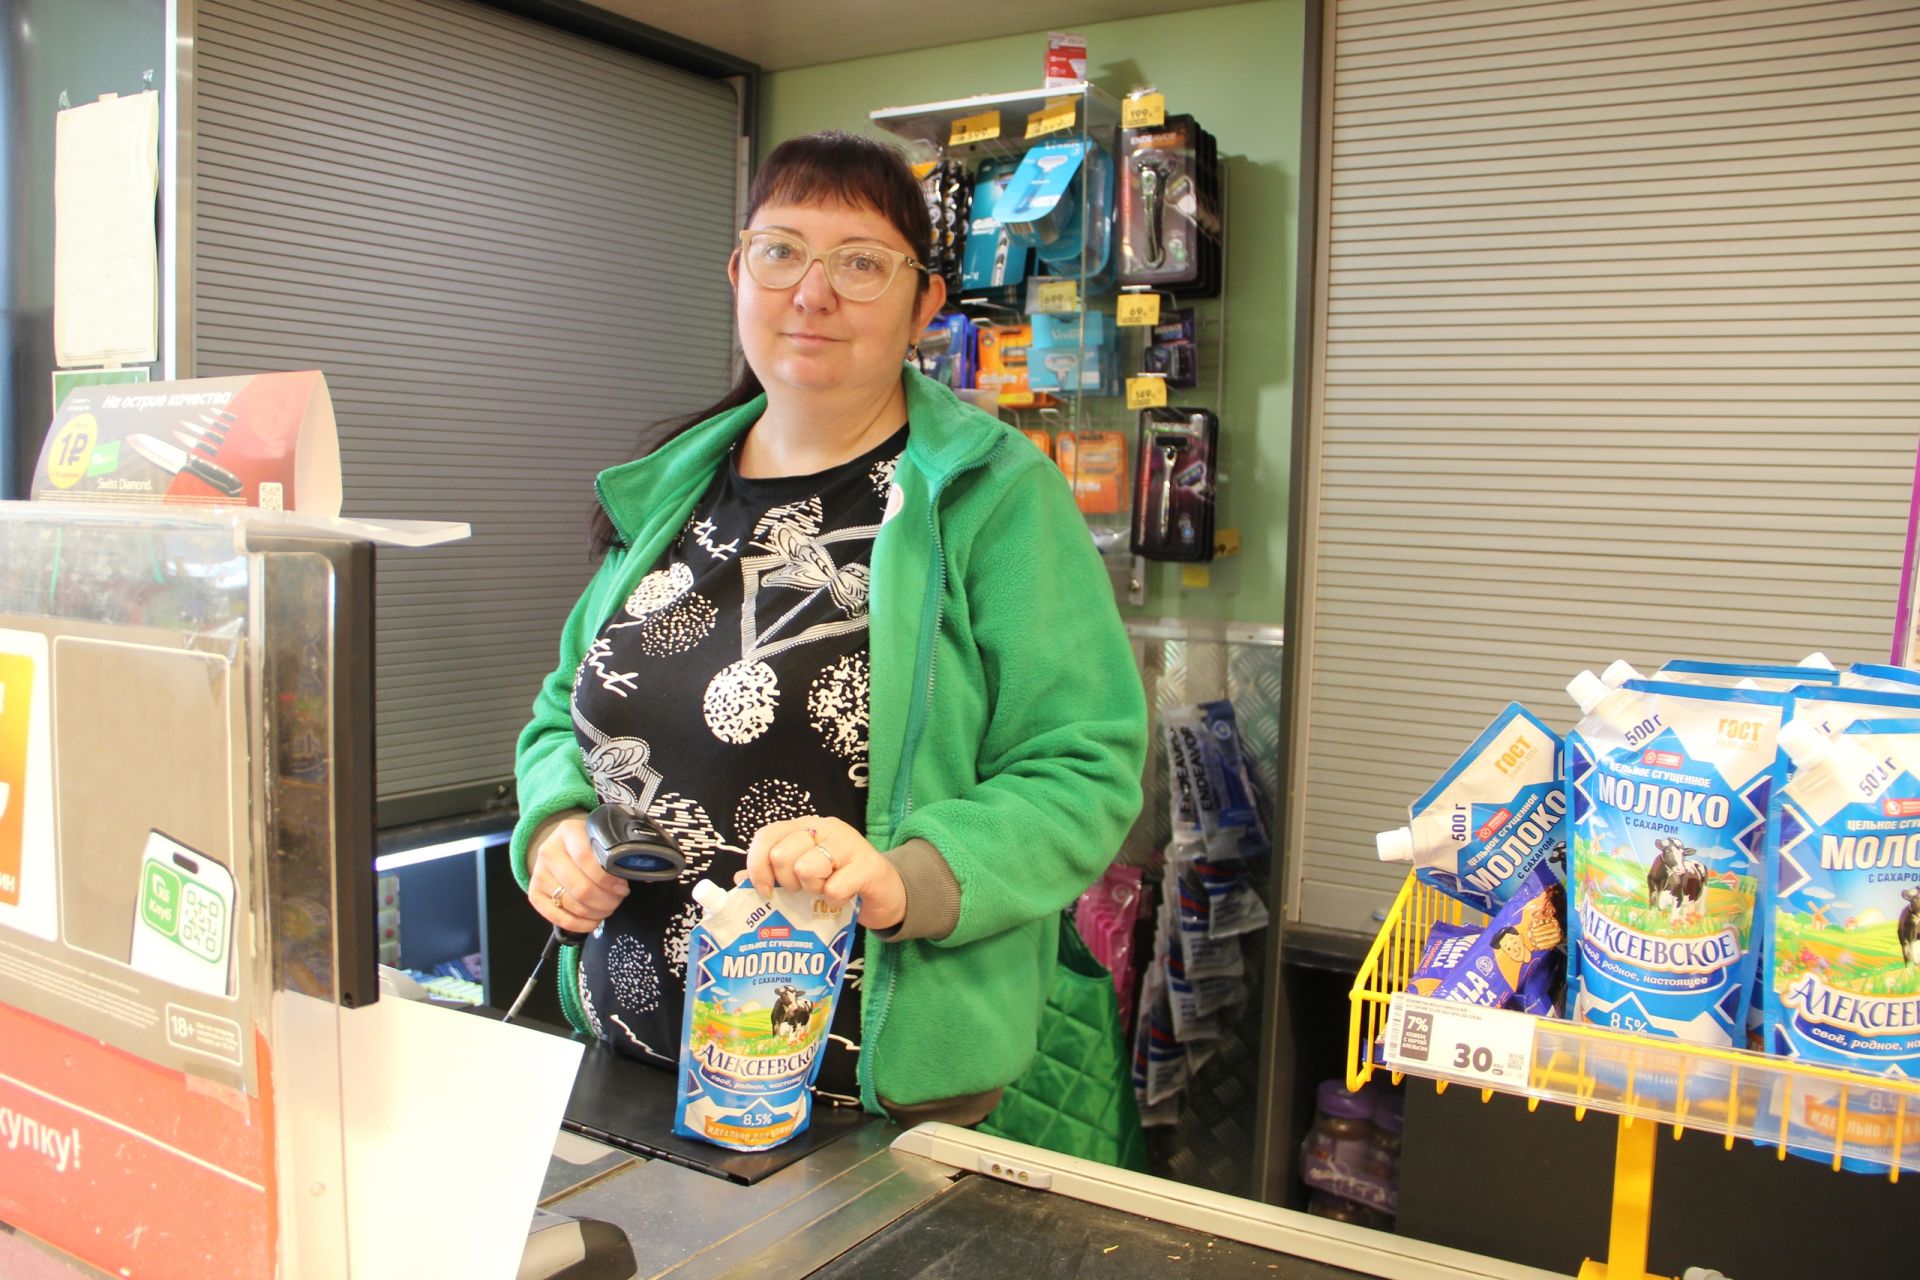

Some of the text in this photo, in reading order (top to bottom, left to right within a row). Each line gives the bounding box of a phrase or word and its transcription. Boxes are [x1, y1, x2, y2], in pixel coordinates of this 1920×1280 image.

[102, 395, 121, 409] На
[97, 478, 118, 489] Swiss
[1624, 713, 1663, 747] 500 г
[1718, 718, 1763, 742] ГОСТ
[1494, 735, 1532, 775] ГОСТ
[1609, 761, 1651, 777] ЦЕЛЬНОЕ
[1650, 768, 1712, 788] СГУЩЕННОЕ
[1597, 772, 1730, 830] МОЛОКО
[1451, 803, 1466, 842] 500 г
[1467, 835, 1500, 867] ЦЕЛЬНОЕ
[1498, 792, 1539, 838] СГУЩЕННОЕ
[1632, 818, 1679, 835] САХАРОМ
[1847, 819, 1898, 831] ЦЕЛЬНОЕ
[1463, 788, 1566, 892] МОЛОКО
[1820, 833, 1920, 871] МОЛО
[1523, 836, 1556, 874] САХАРОМ
[1877, 872, 1920, 883] САХАРО
[745, 901, 773, 929] 500 г
[739, 940, 814, 953] ЦЕЛЬНОЕ СГУЩЕННОЕ
[721, 950, 826, 979] МОЛОКО
[1601, 960, 1640, 982] родное,
[1643, 975, 1709, 989] настоящее
[758, 976, 792, 986] САХАРОМ
[1788, 977, 1920, 1030] АЛЕКСЕЕ
[170, 1015, 195, 1037] 18+
[1406, 1015, 1429, 1033] 7%
[1811, 1027, 1848, 1046] своё,
[1850, 1040, 1903, 1052] родное,
[1453, 1042, 1493, 1073] 30
[743, 1113, 773, 1126] 8,5%
[1811, 1110, 1880, 1138] ИДЕЛЬНО
